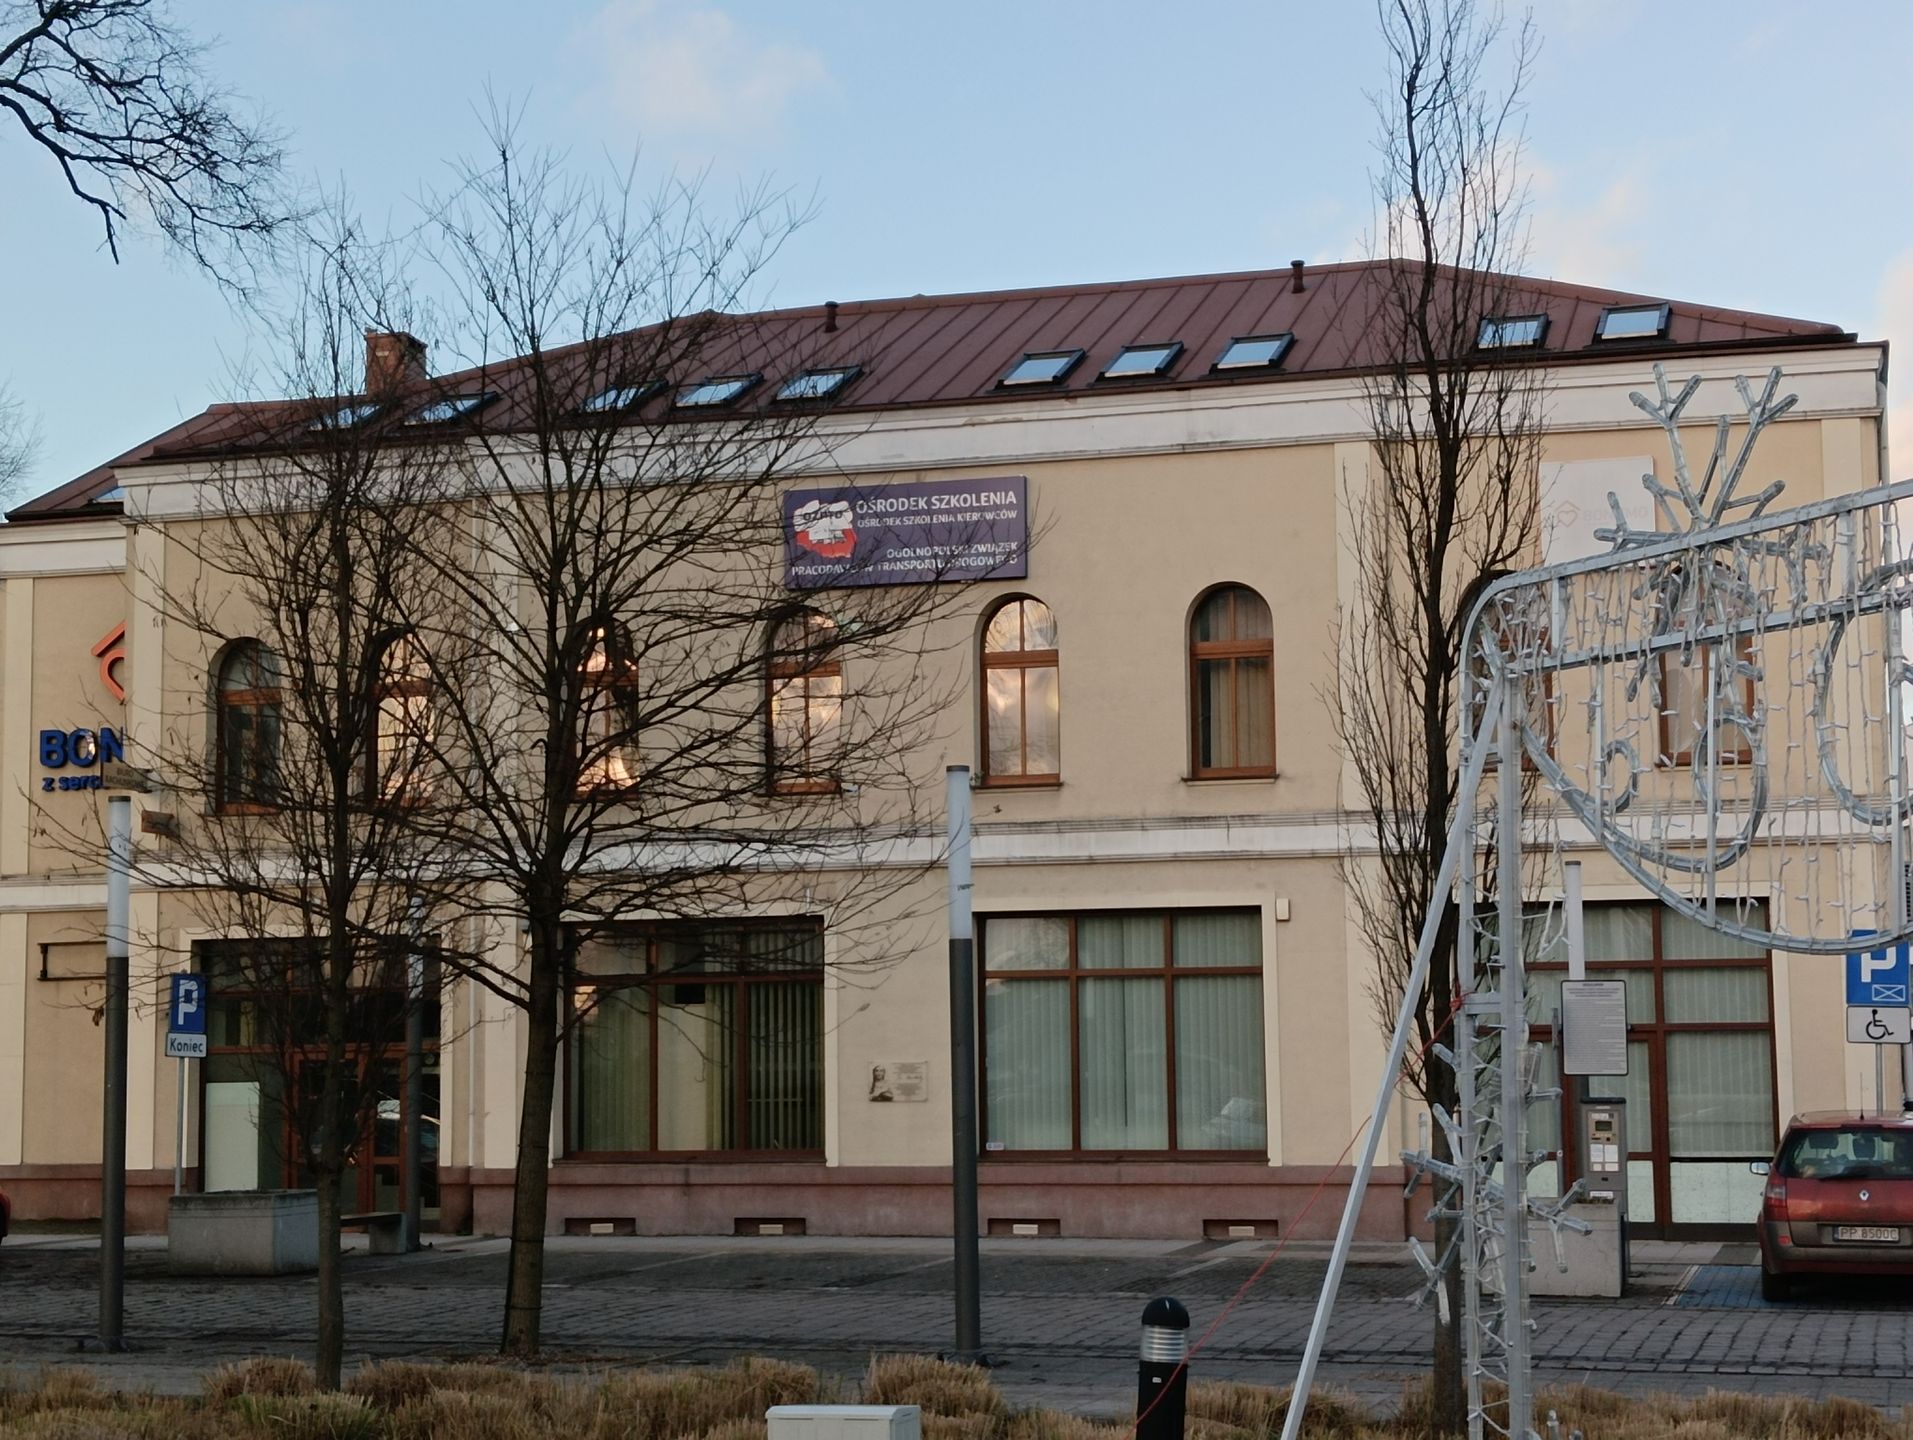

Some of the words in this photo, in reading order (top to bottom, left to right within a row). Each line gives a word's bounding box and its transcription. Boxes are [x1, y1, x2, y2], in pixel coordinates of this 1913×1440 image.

[856, 496, 928, 513] OŚRODEK
[931, 490, 1017, 509] SZKOLENIA
[857, 515, 902, 528] OŚRODEK
[903, 513, 955, 526] SZKOLENIA
[957, 509, 1018, 522] KIEROWCÓW
[178, 979, 198, 1025] P
[169, 1037, 203, 1053] Koniec
[1840, 1227, 1857, 1239] PP
